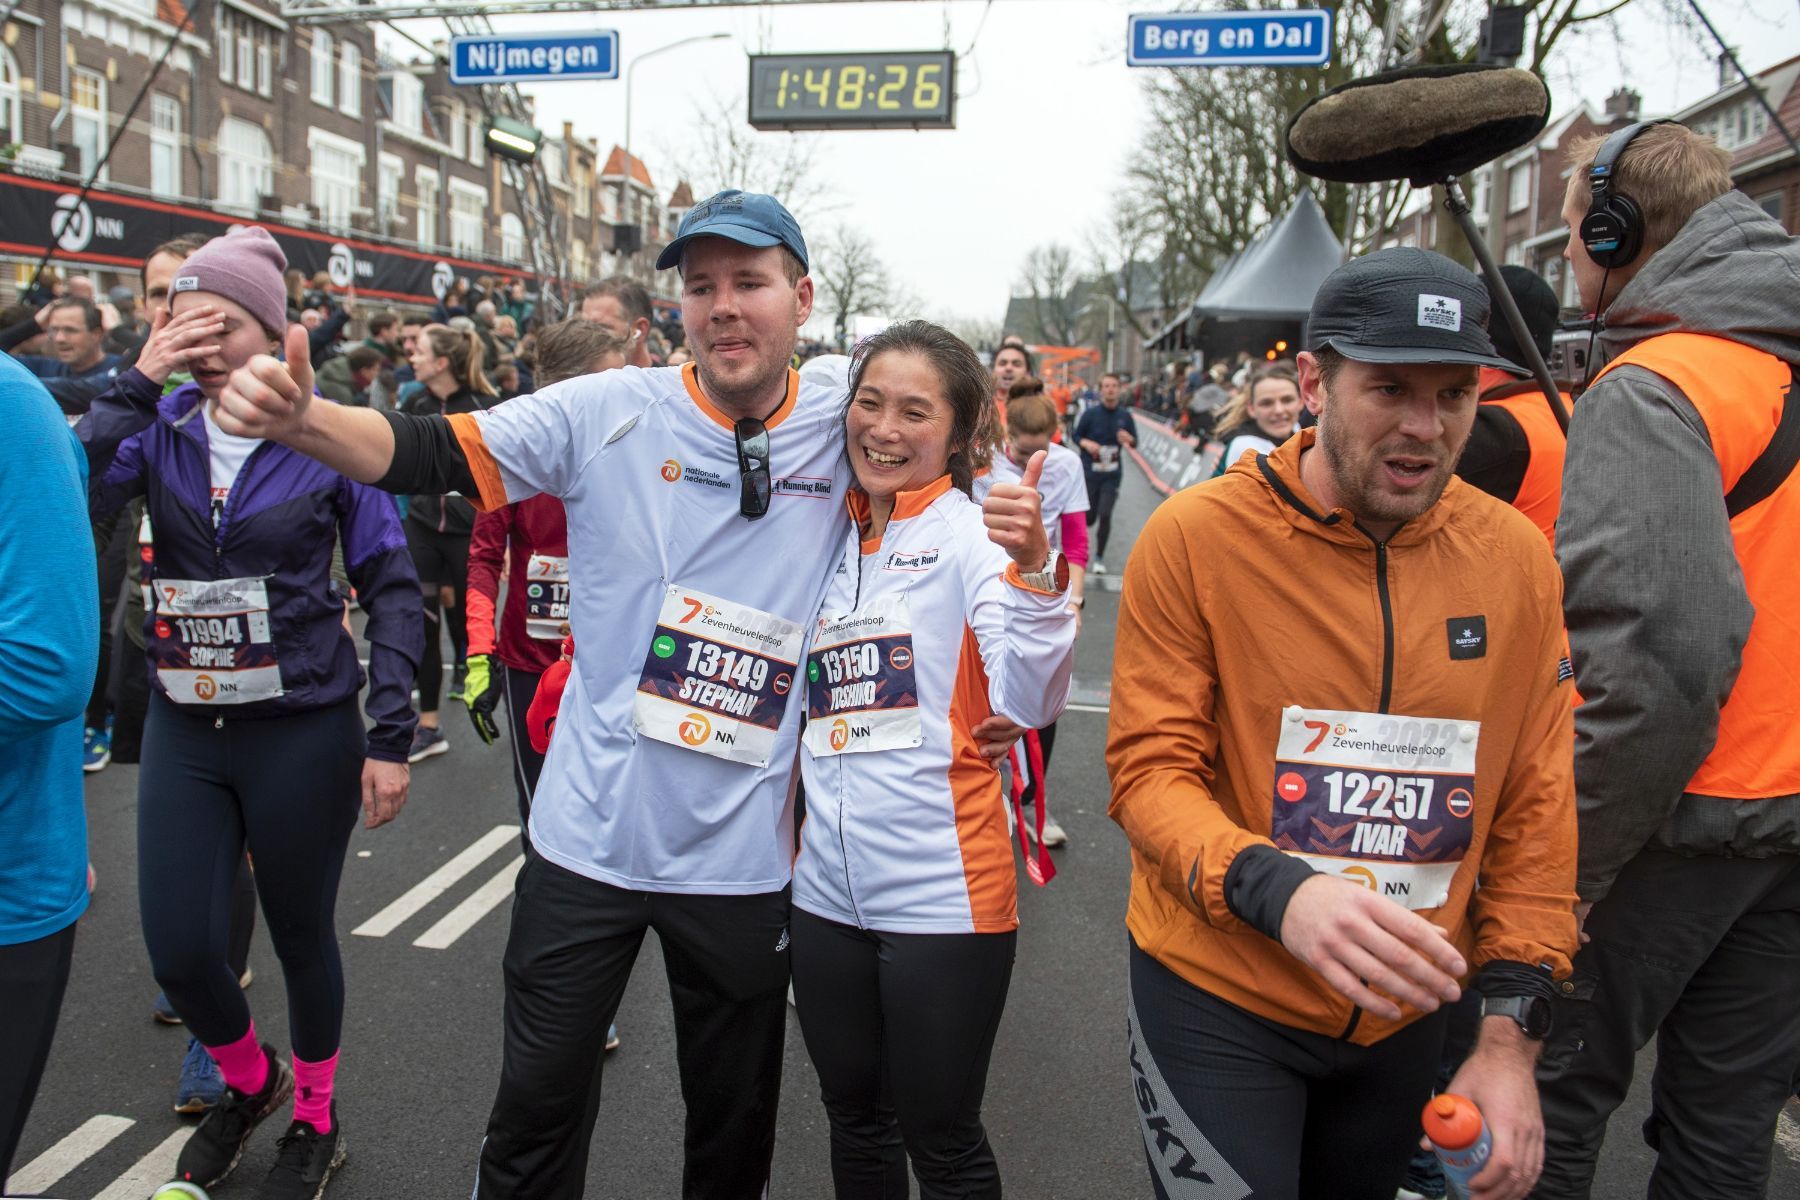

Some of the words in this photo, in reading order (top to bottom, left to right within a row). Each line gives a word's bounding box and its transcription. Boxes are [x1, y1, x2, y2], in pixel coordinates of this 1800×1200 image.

[1144, 24, 1210, 55] Berg
[1218, 27, 1254, 48] en
[1264, 21, 1312, 48] Dal
[468, 43, 598, 75] Nijmegen
[776, 64, 942, 110] 1:48:26
[95, 215, 124, 240] NN
[1424, 306, 1456, 317] SAYSKY
[684, 474, 731, 489] nederlanden
[685, 466, 721, 480] nationale
[783, 480, 813, 493] Running
[814, 481, 832, 494] Blind
[539, 560, 551, 576] 7
[164, 587, 176, 607] 7
[531, 605, 539, 613] R
[679, 597, 703, 624] 7
[175, 617, 242, 645] 11994
[701, 615, 782, 648] Zevenheuvelenloop
[1455, 636, 1481, 645] SAYSKY
[189, 646, 235, 667] SOPHIE
[686, 640, 769, 691] 13149
[821, 642, 880, 684] 13150
[220, 683, 238, 692] NN
[678, 677, 759, 717] STEPHAN
[715, 730, 735, 746] NN
[851, 726, 871, 738] NN
[1303, 720, 1330, 754] 7
[1371, 719, 1459, 768] 2022
[1332, 736, 1446, 758] Zevenheuvelenloop
[1323, 771, 1435, 820] 12257
[1350, 821, 1408, 856] IVAR
[1384, 882, 1411, 896] NN
[1128, 1018, 1215, 1184] YSKY
